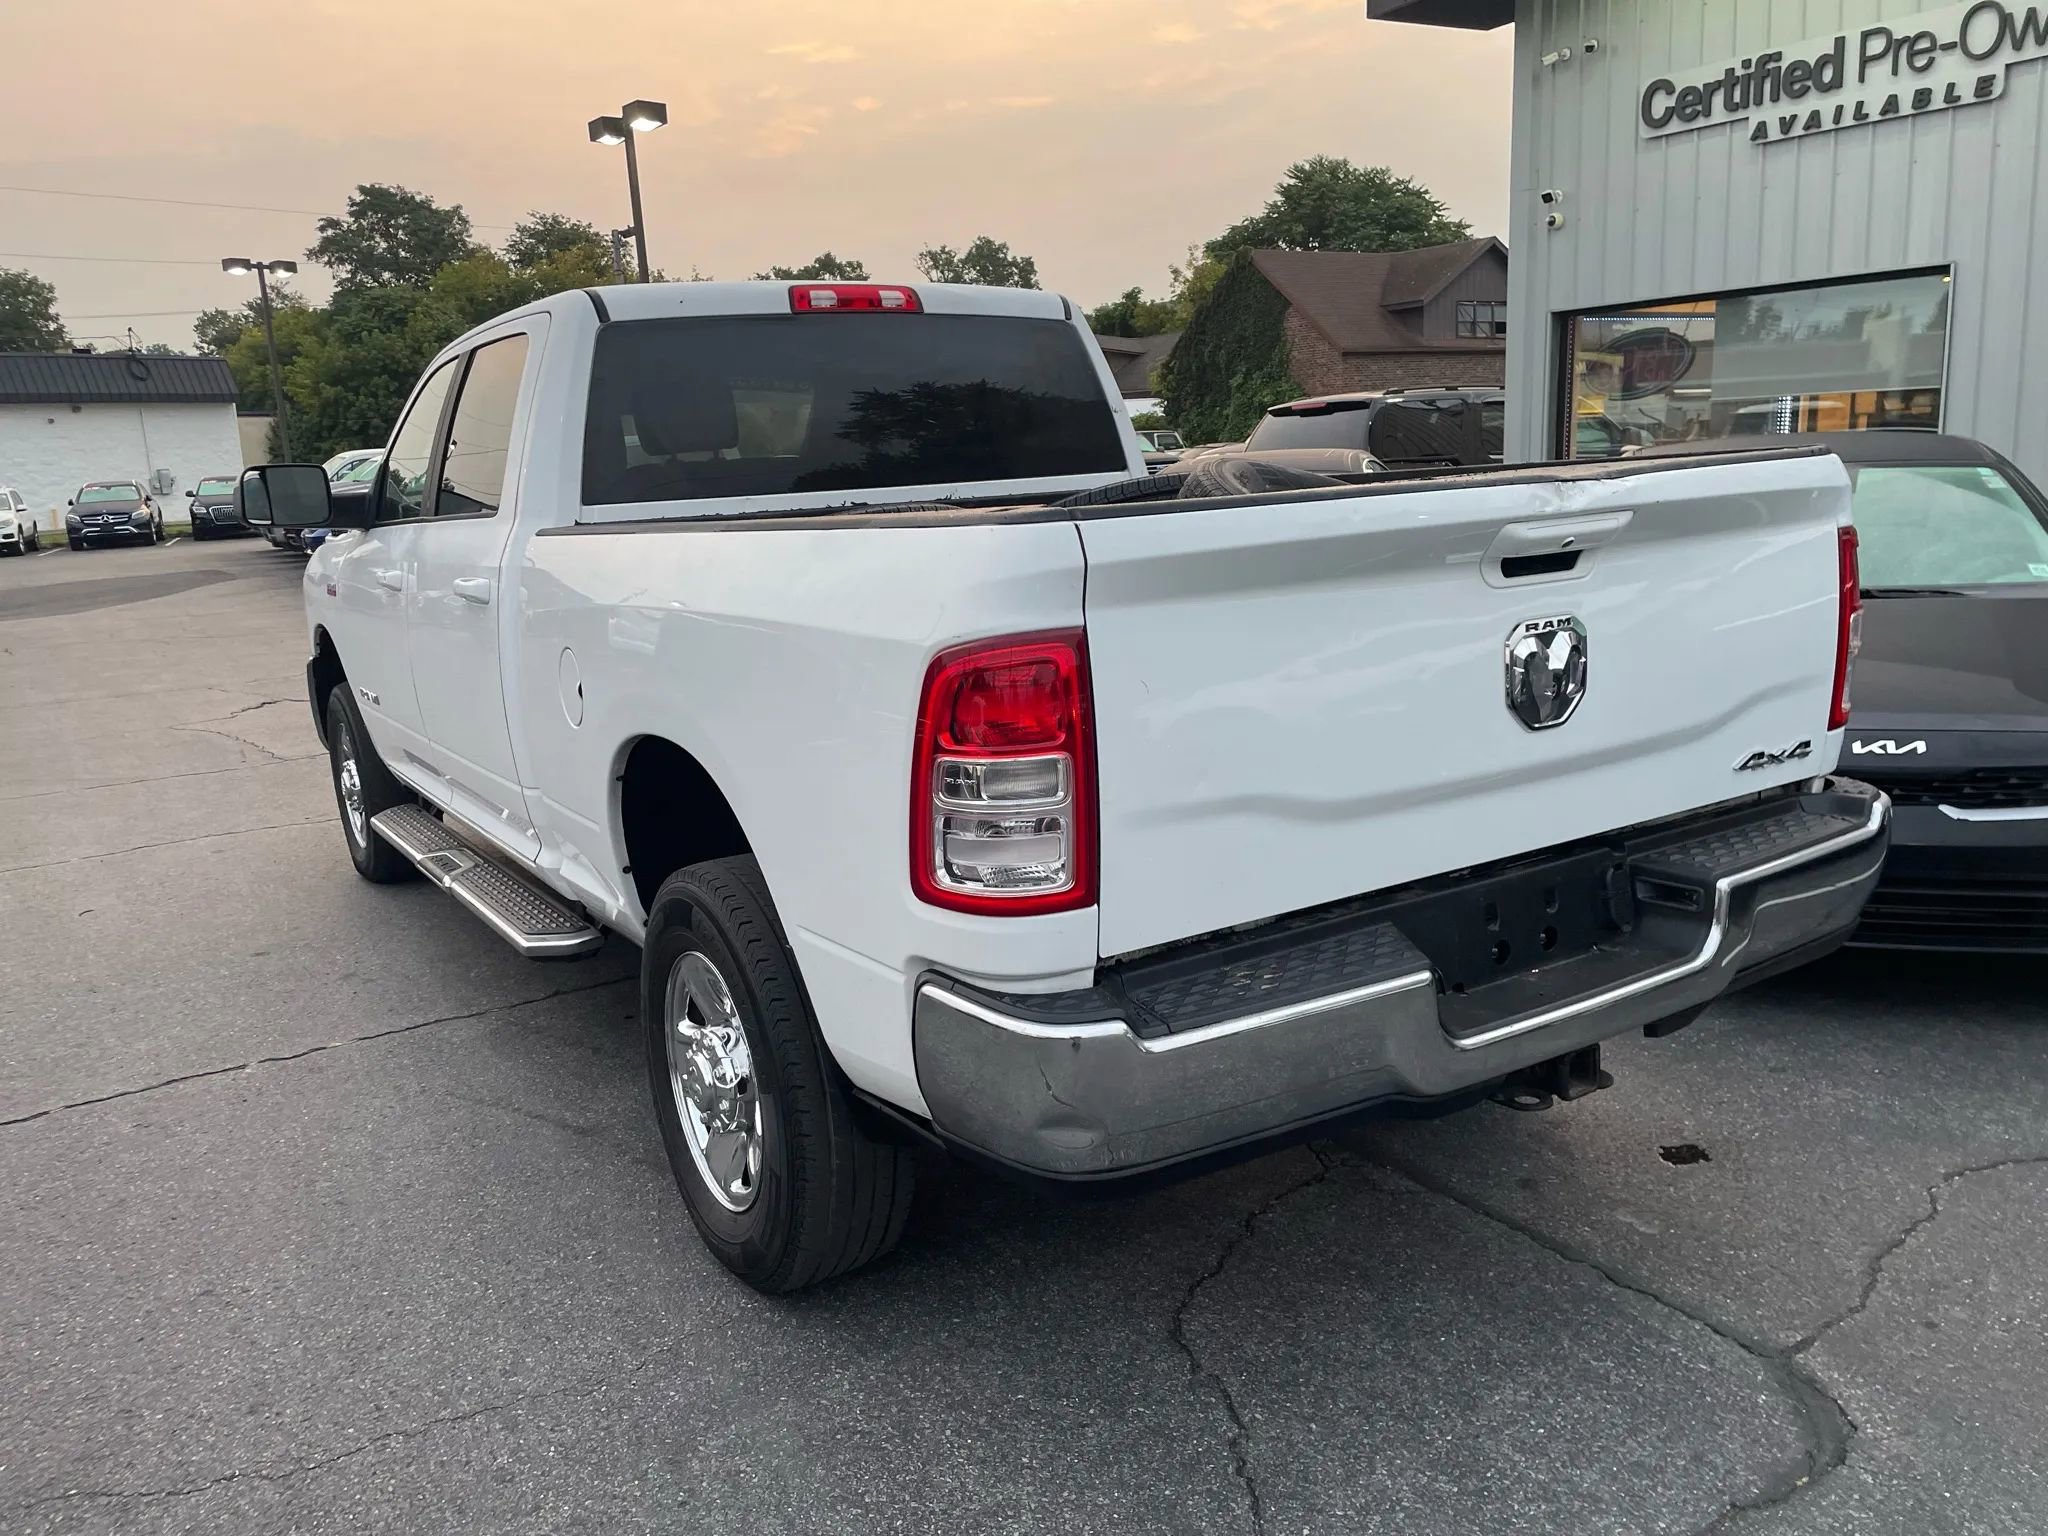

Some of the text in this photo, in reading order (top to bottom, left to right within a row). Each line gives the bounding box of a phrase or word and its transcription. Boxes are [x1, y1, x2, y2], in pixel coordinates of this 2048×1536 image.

[1641, 36, 1846, 129] Certified
[1749, 74, 1997, 142] AVAILABLE
[1525, 617, 1573, 633] RAM
